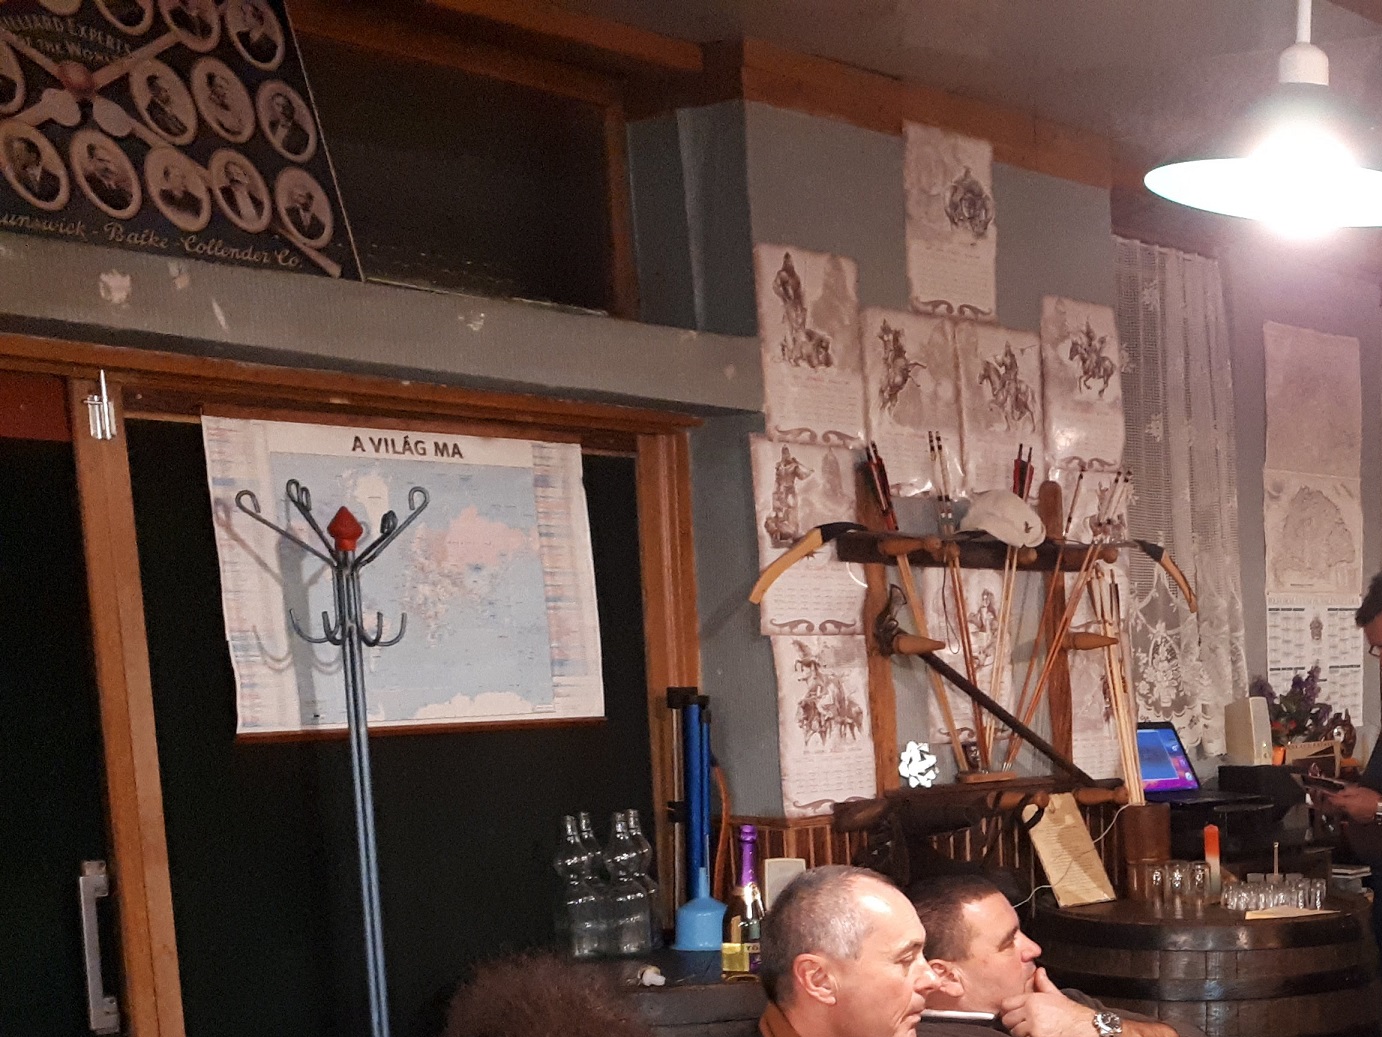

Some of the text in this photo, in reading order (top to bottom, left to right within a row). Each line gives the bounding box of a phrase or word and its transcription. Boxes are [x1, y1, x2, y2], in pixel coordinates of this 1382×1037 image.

[352, 434, 464, 459] A VILÁG MA
